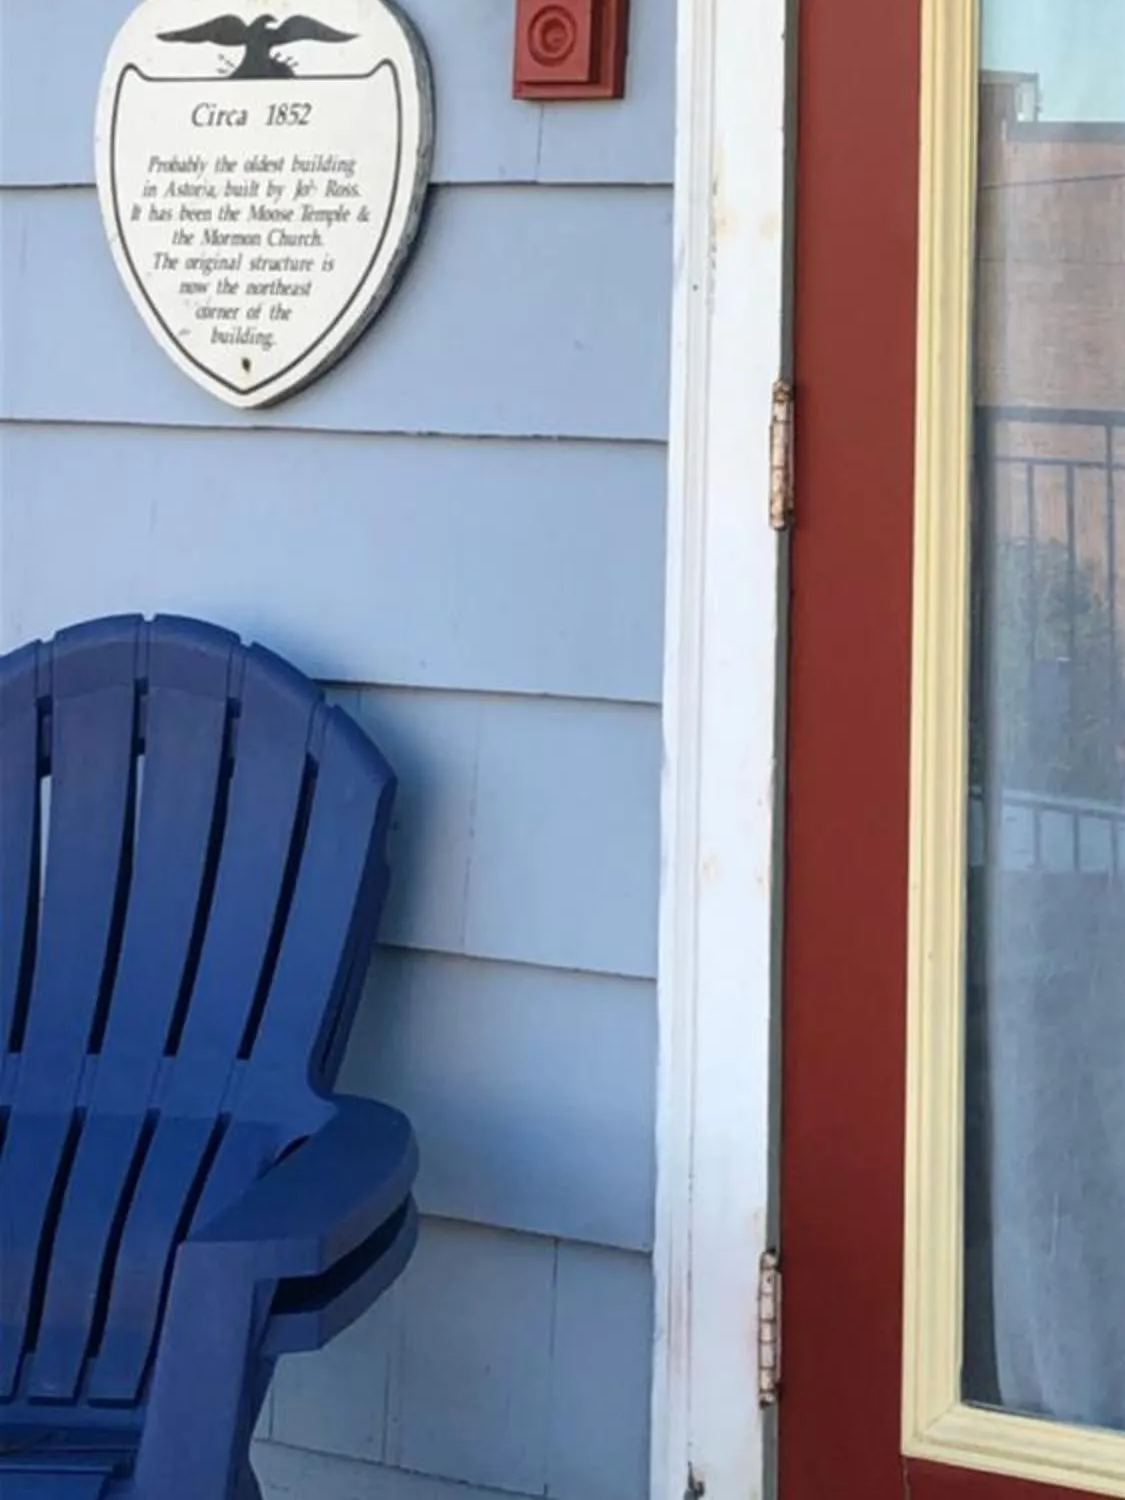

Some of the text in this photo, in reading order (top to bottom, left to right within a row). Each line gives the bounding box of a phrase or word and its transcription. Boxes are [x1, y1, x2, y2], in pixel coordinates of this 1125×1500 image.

[190, 102, 314, 128] Circa 1852
[148, 155, 357, 180] Probably the oldest building
[142, 180, 159, 197] in
[164, 181, 217, 199] Astoria,
[224, 180, 261, 197] built
[266, 180, 284, 202] by
[131, 204, 371, 228] It has been the Moose Temple &
[172, 228, 325, 247] the Mormon Church.
[153, 252, 335, 276] The original structure is
[178, 278, 314, 298] now the northeast
[195, 303, 293, 322] corner of the
